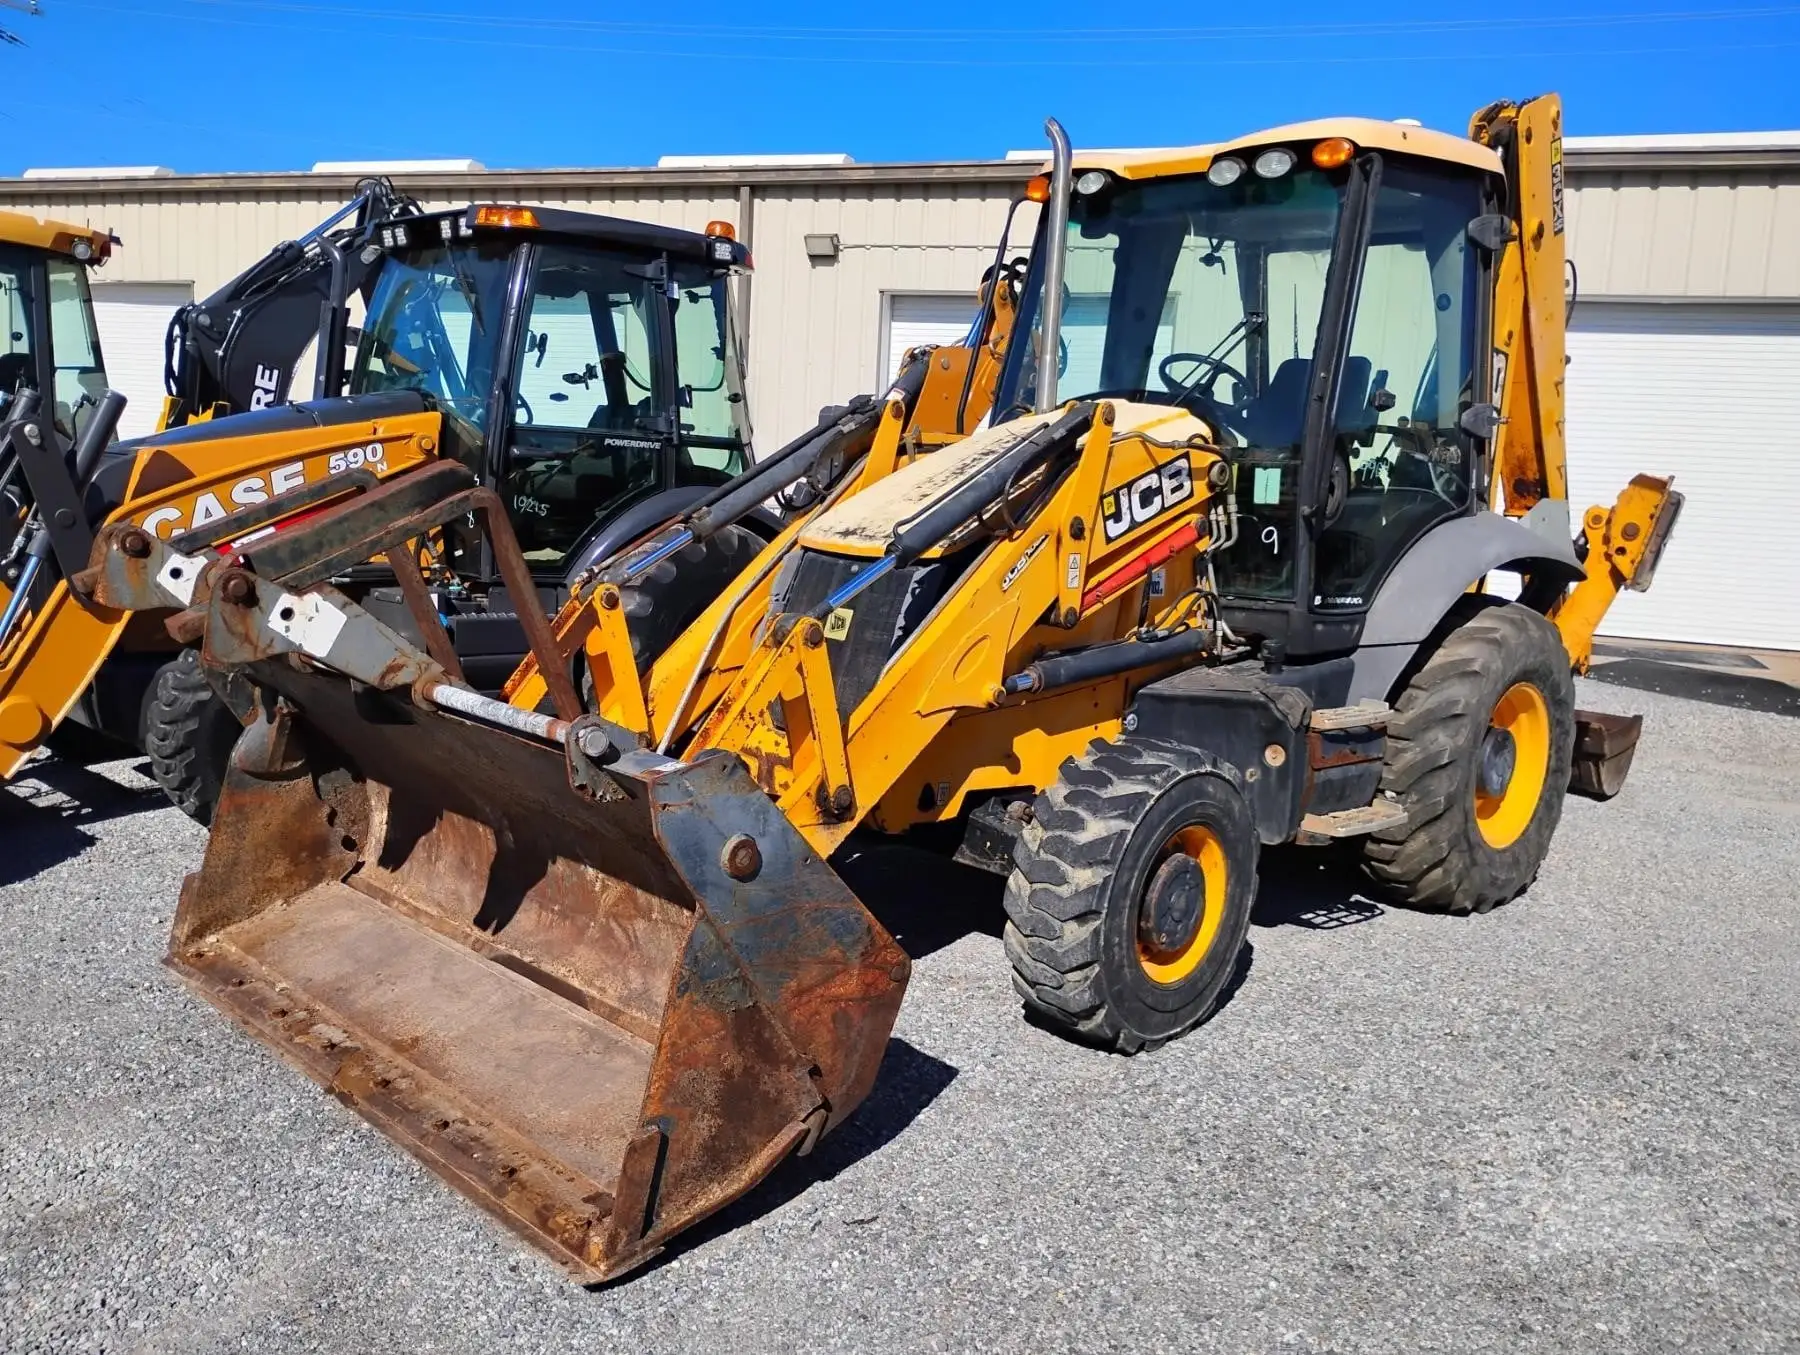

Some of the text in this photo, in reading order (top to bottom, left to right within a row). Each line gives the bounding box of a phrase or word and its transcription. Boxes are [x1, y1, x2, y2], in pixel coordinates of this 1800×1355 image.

[328, 443, 383, 475] 590
[604, 438, 662, 450] POWERDRIVE
[141, 461, 306, 540] CASE
[1105, 458, 1192, 540] JCB
[1261, 526, 1278, 554] 9
